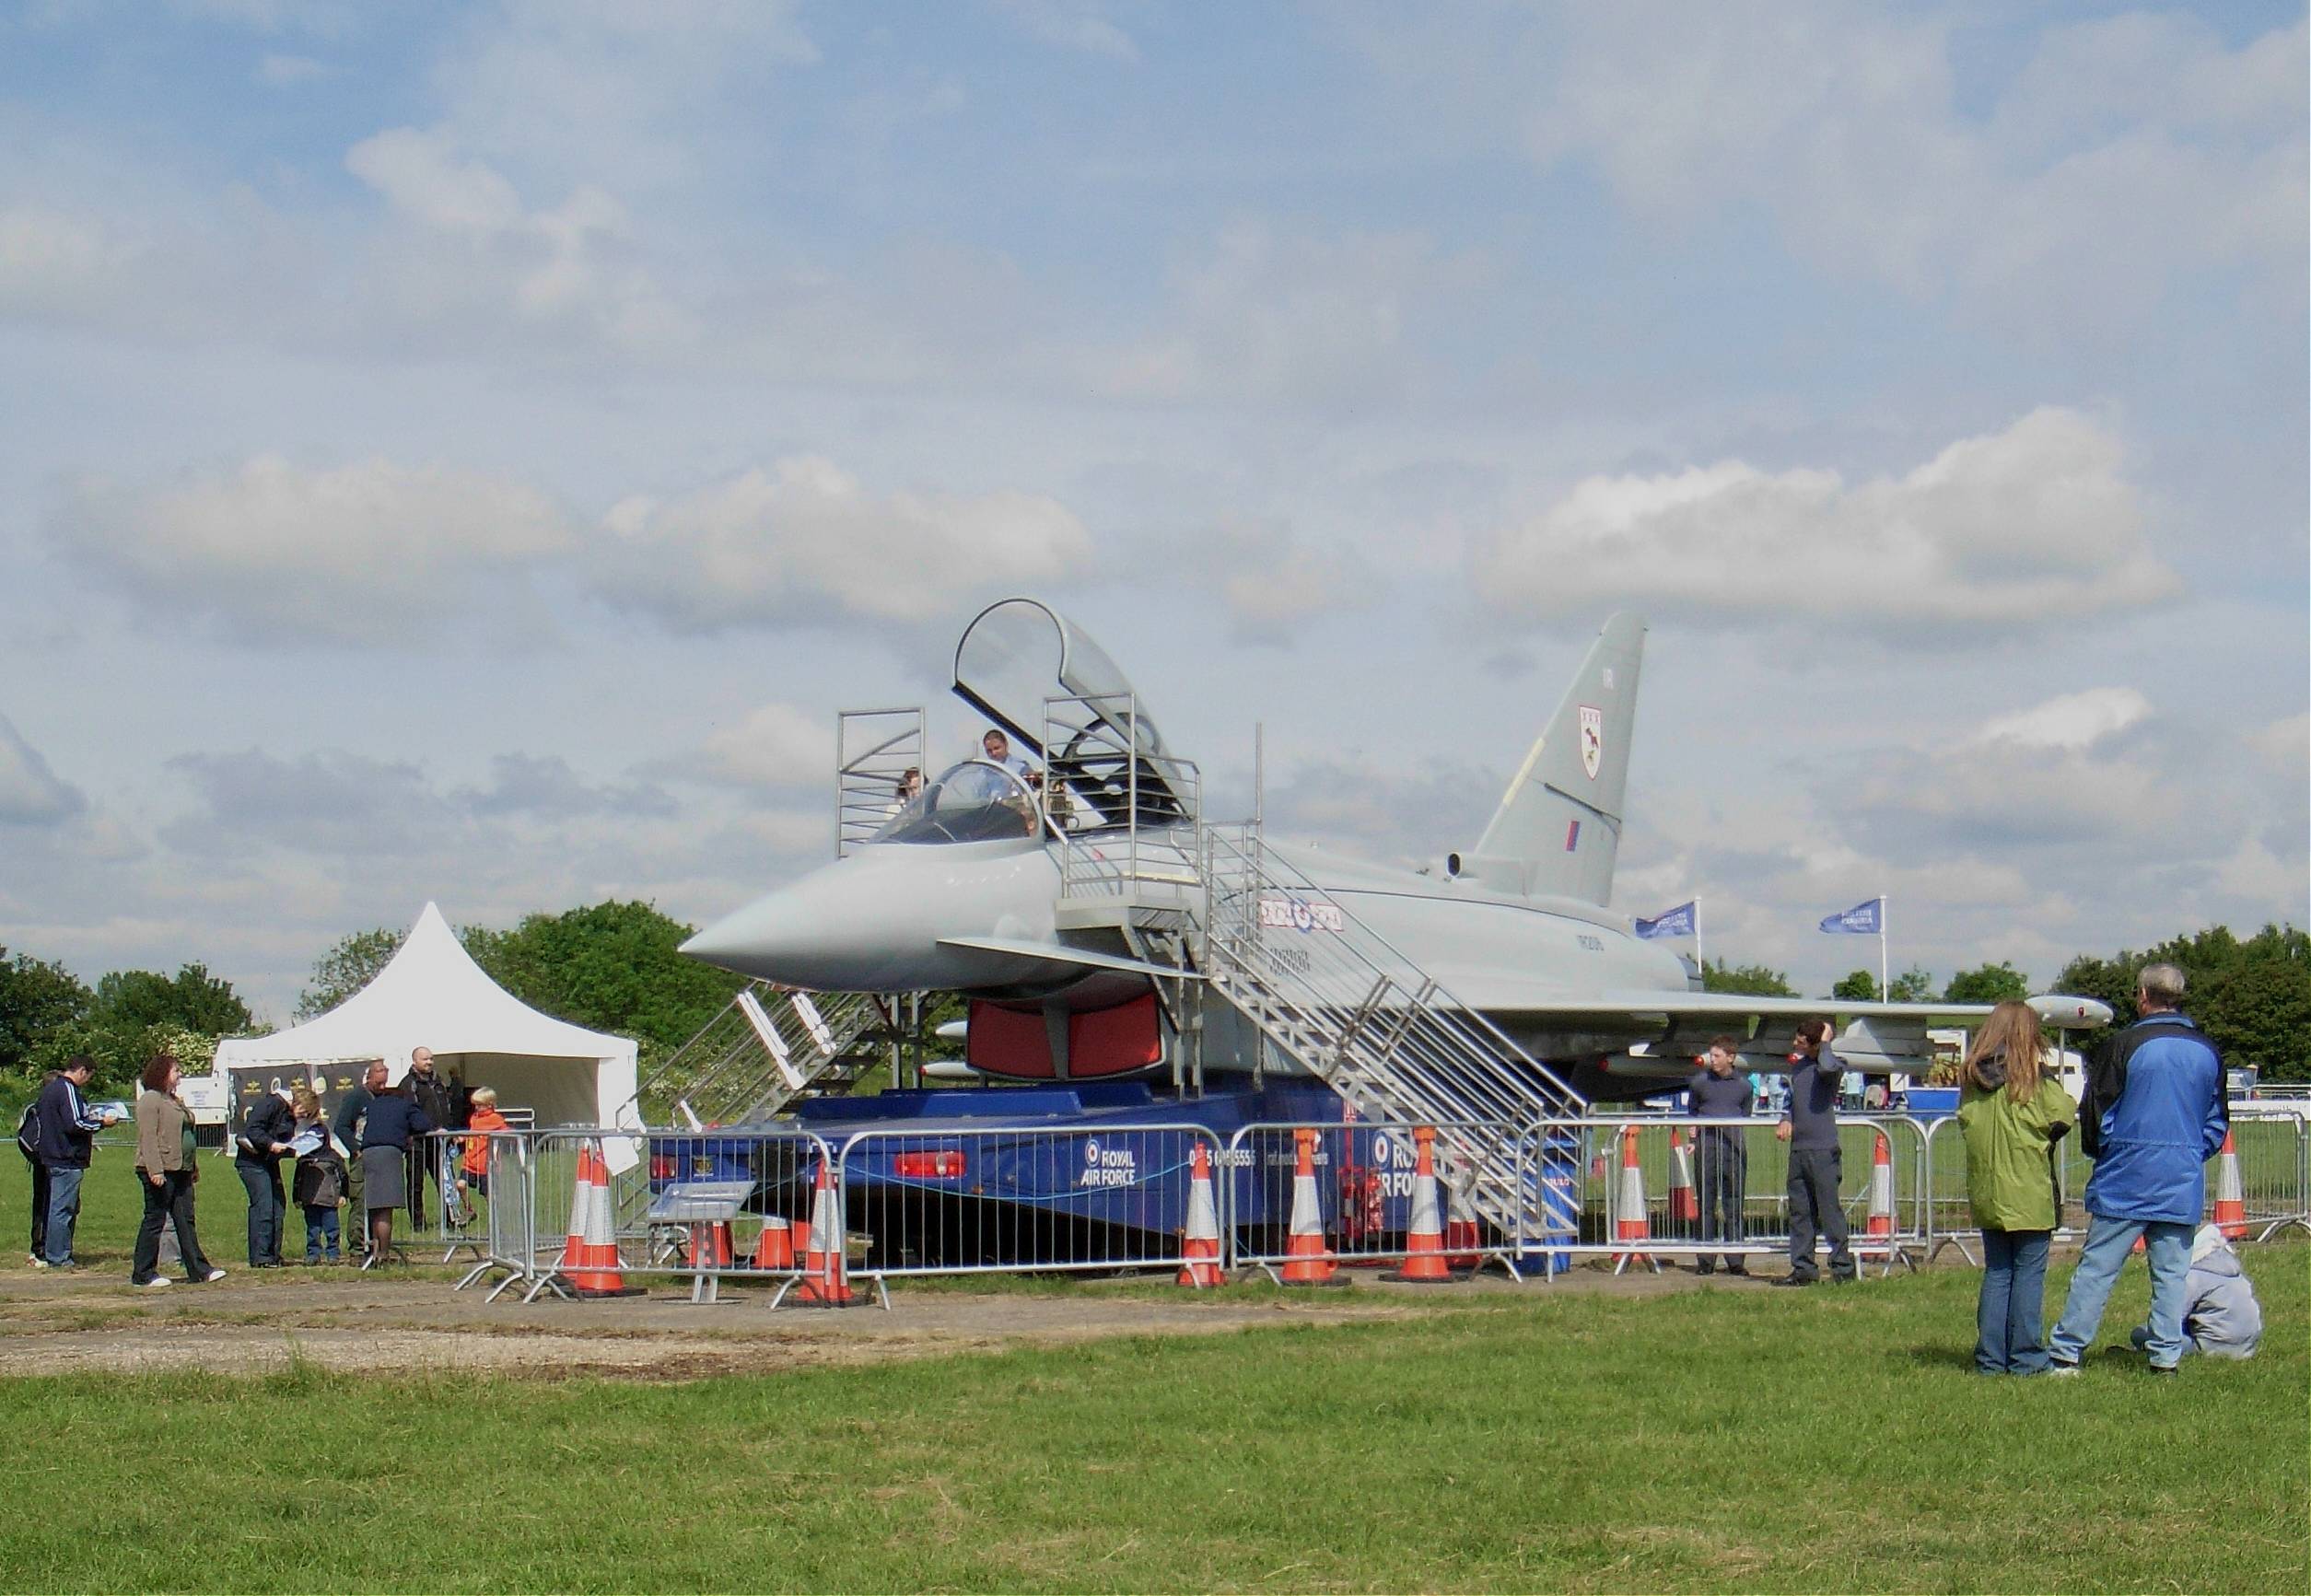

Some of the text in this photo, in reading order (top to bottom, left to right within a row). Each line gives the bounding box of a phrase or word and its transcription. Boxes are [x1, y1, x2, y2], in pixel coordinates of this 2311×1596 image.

[1102, 1150, 1136, 1167] ROYAL
[1189, 1149, 1212, 1167] 05
[1080, 1169, 1136, 1186] AIR FORCE
